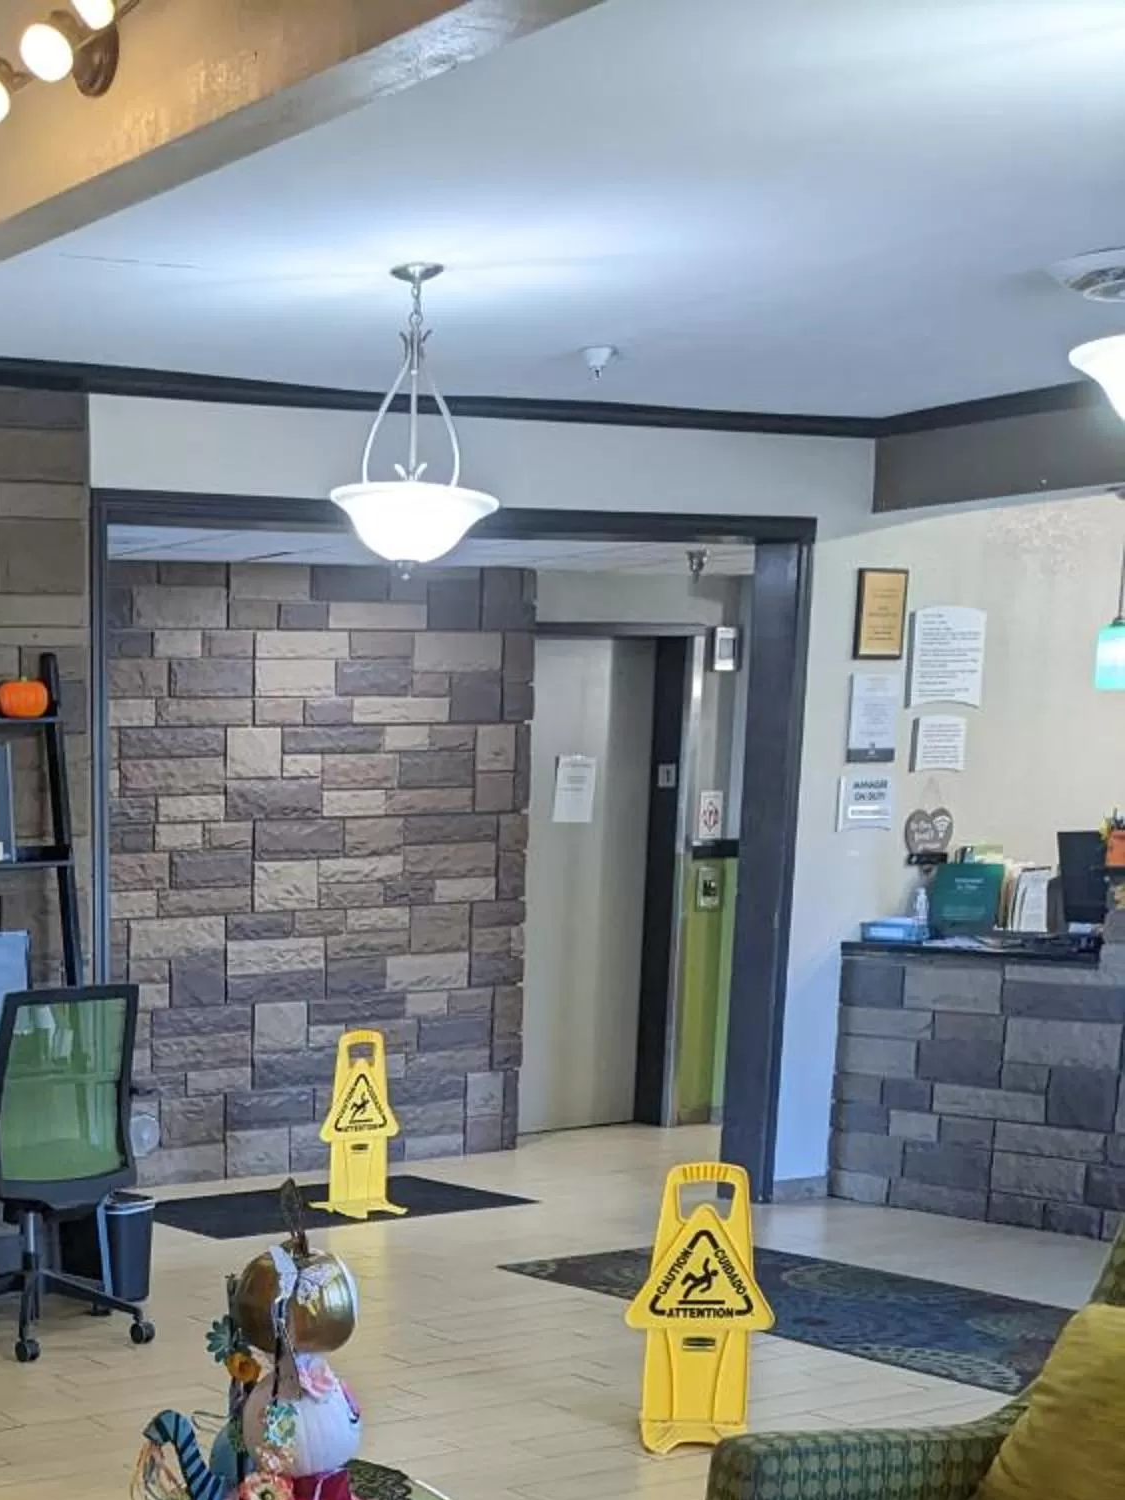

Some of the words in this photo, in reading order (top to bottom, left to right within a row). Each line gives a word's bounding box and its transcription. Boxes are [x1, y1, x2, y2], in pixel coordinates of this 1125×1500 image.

[657, 1248, 693, 1294] CAUTION
[714, 1249, 746, 1294] CUIDADO
[667, 1307, 733, 1318] ATTENTION
